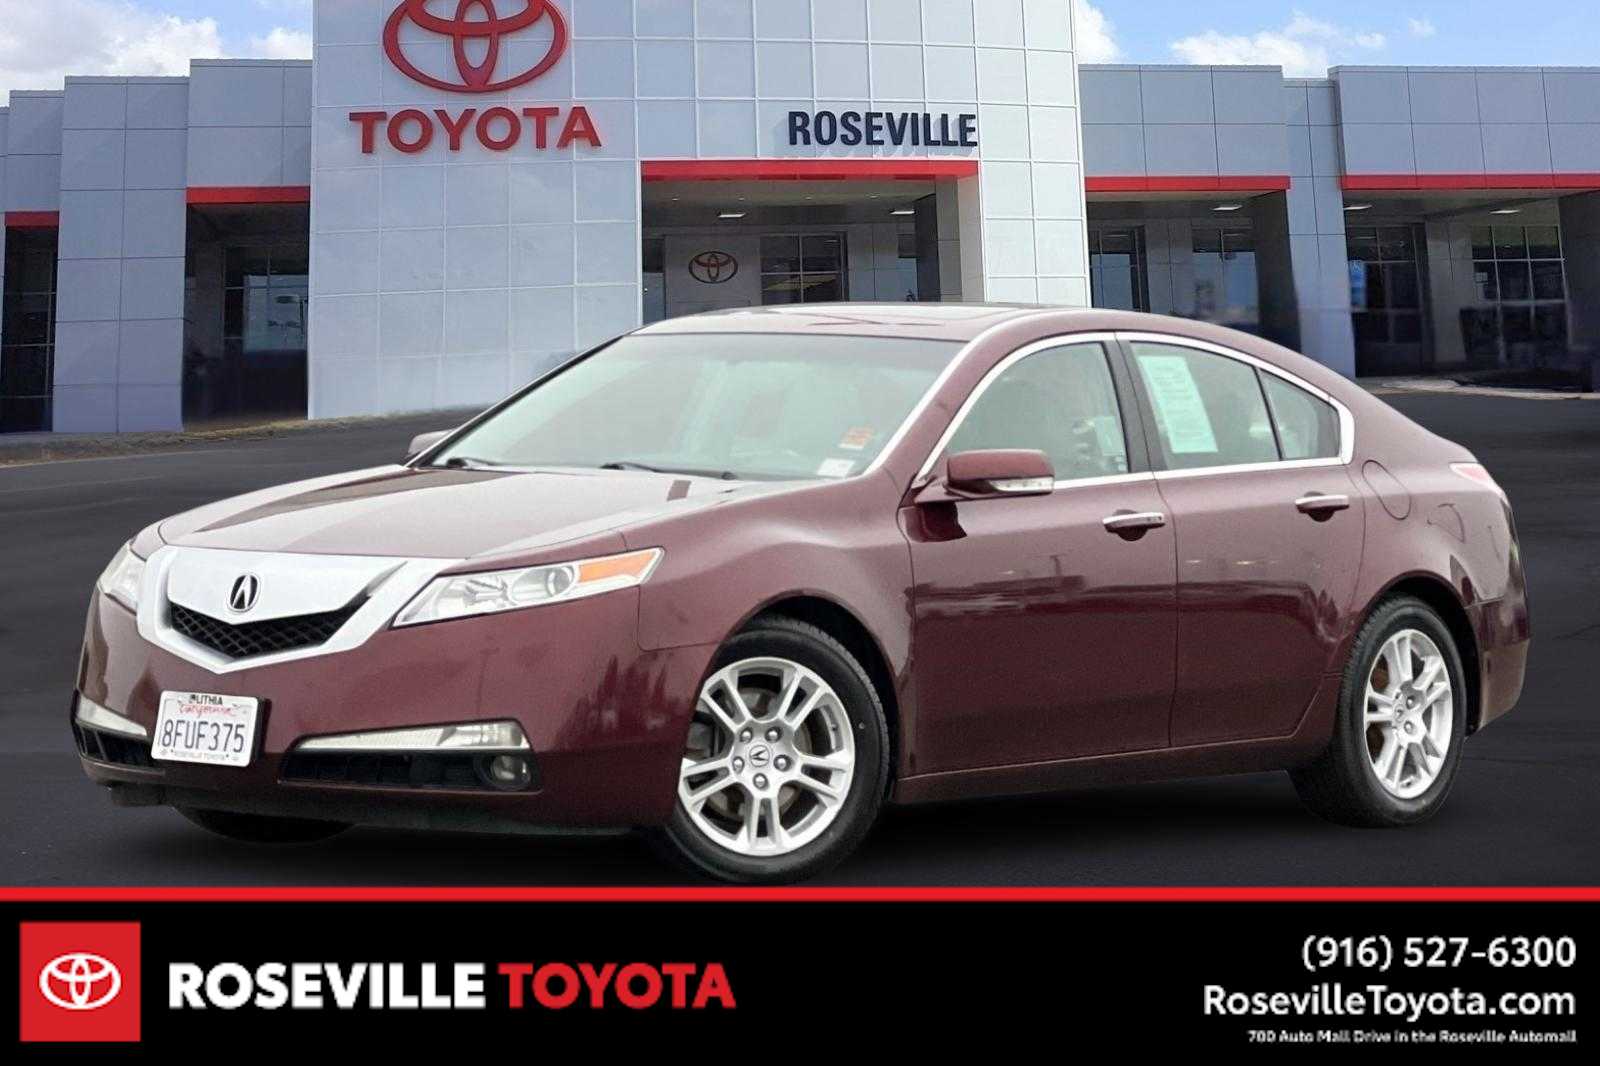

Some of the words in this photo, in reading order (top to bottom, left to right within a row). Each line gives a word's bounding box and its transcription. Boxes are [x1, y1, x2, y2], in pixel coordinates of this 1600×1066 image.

[349, 106, 602, 154] TOYOTA
[788, 110, 978, 147] ROSEVILLE
[196, 694, 223, 705] LITHIA
[161, 719, 245, 753] 8FUF375
